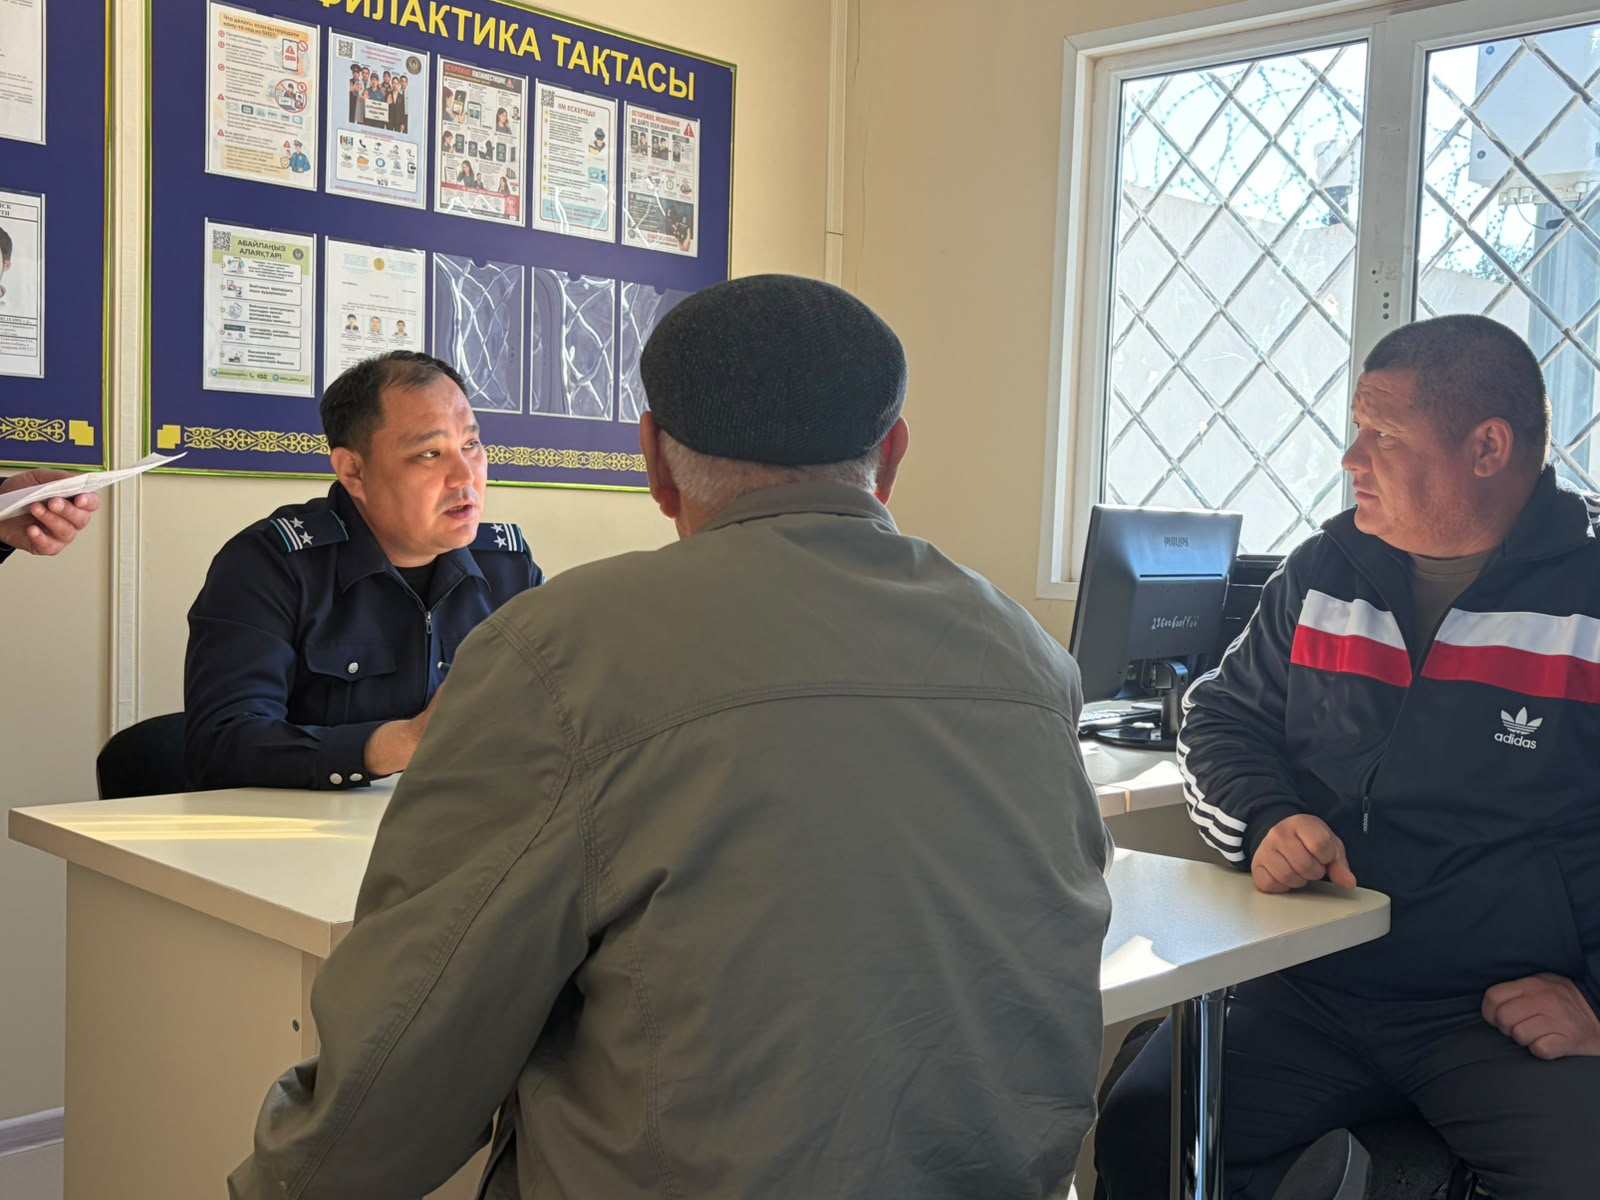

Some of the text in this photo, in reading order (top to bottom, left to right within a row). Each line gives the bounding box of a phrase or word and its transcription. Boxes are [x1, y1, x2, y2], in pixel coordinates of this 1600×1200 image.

[318, 0, 542, 62] ЛАКТИКА
[551, 33, 695, 101] ТАҚТАСЫ
[237, 239, 287, 252] АБАЙЛАҢЫЗ
[1164, 536, 1189, 548] PHILIPS
[1494, 732, 1537, 749] adidas
